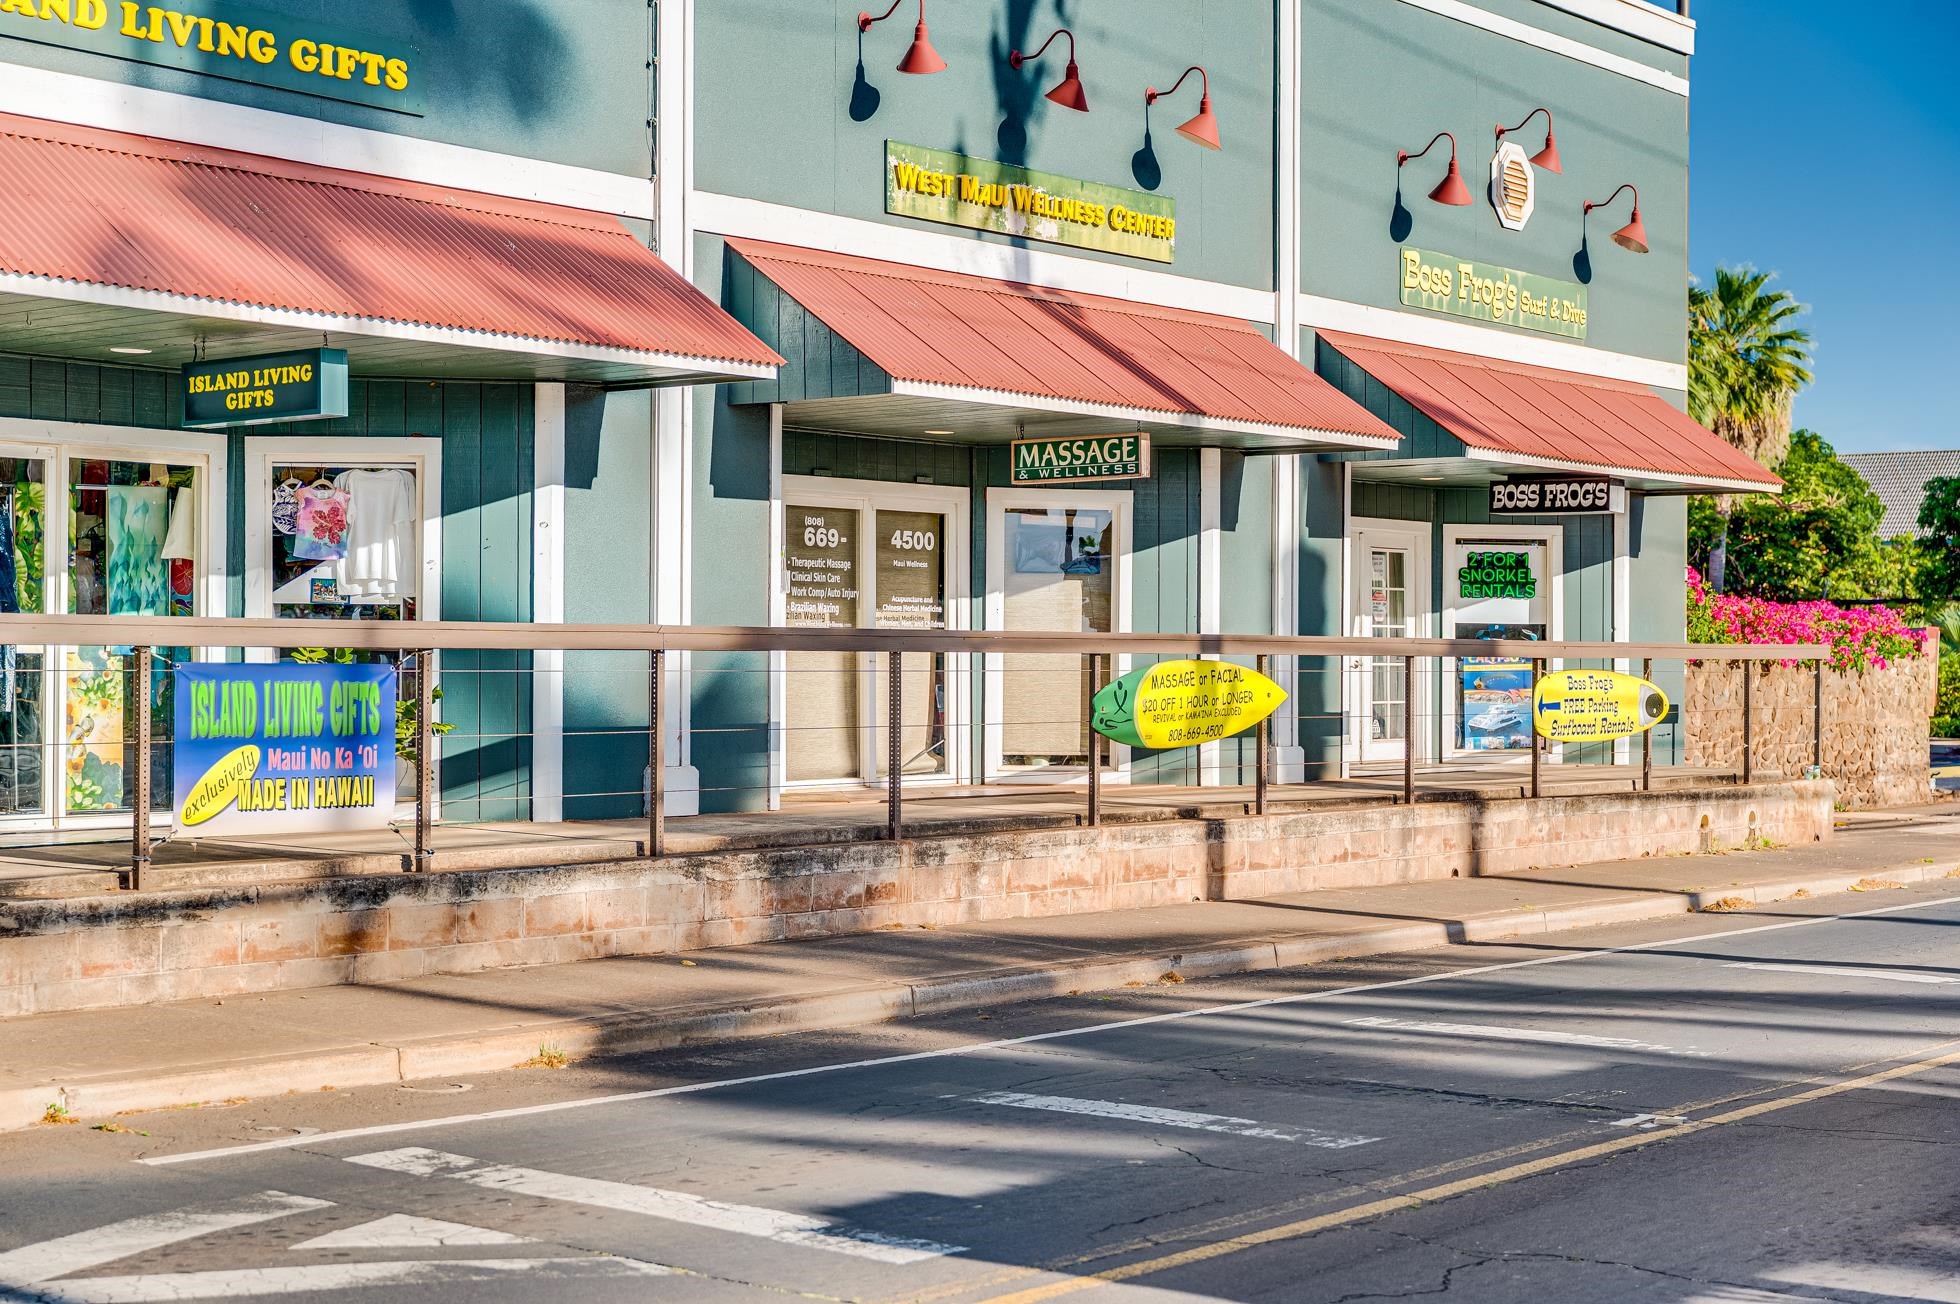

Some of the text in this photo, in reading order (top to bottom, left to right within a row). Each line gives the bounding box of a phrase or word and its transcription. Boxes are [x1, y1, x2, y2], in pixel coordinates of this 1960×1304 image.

[119, 1, 278, 64] LIVING
[289, 38, 409, 91] GIFTS
[894, 161, 1176, 240] WEST MAUI WELLNESS CENTER
[1403, 250, 1587, 326] Boss Frog's Surf & Dive
[188, 364, 313, 394] ISLAND LIVING
[225, 389, 274, 410] GIFTS
[1020, 438, 1136, 468] MASSAGE
[1019, 463, 1136, 480] & WELLNESS
[1492, 482, 1608, 509] BOSS FROG'S
[804, 515, 825, 528] (808)
[890, 529, 935, 551] 4500
[791, 556, 852, 572] Therapeutic Massage
[1468, 553, 1529, 567] 2 FOR 1
[791, 571, 841, 583] Clinical Skin Care
[1460, 568, 1536, 583] SNORKEL
[791, 586, 808, 598] Work
[841, 588, 860, 601] Injury
[1461, 584, 1536, 598] RENTALS
[790, 601, 840, 616] Brazilian Waxing
[1151, 668, 1245, 691] MASSAGE or FACIAL
[1566, 675, 1614, 695] Boss Frog's
[191, 679, 382, 739] ISLAND LIVING GIFTS
[1142, 690, 1254, 714] $20 OFF 1 HOUR or LONGER
[1563, 698, 1619, 716] FREE Parking
[1152, 713, 1177, 724] REVIVAL
[1214, 706, 1242, 718] EXCLUDED
[1167, 724, 1224, 742] 808-669-4500
[1550, 716, 1634, 737] Surfboard Rentals
[267, 745, 306, 772] Maui
[310, 747, 331, 771] No
[334, 747, 354, 770] Ka
[184, 749, 256, 820] exclusively
[237, 775, 375, 813] MADE IN HAWAII
